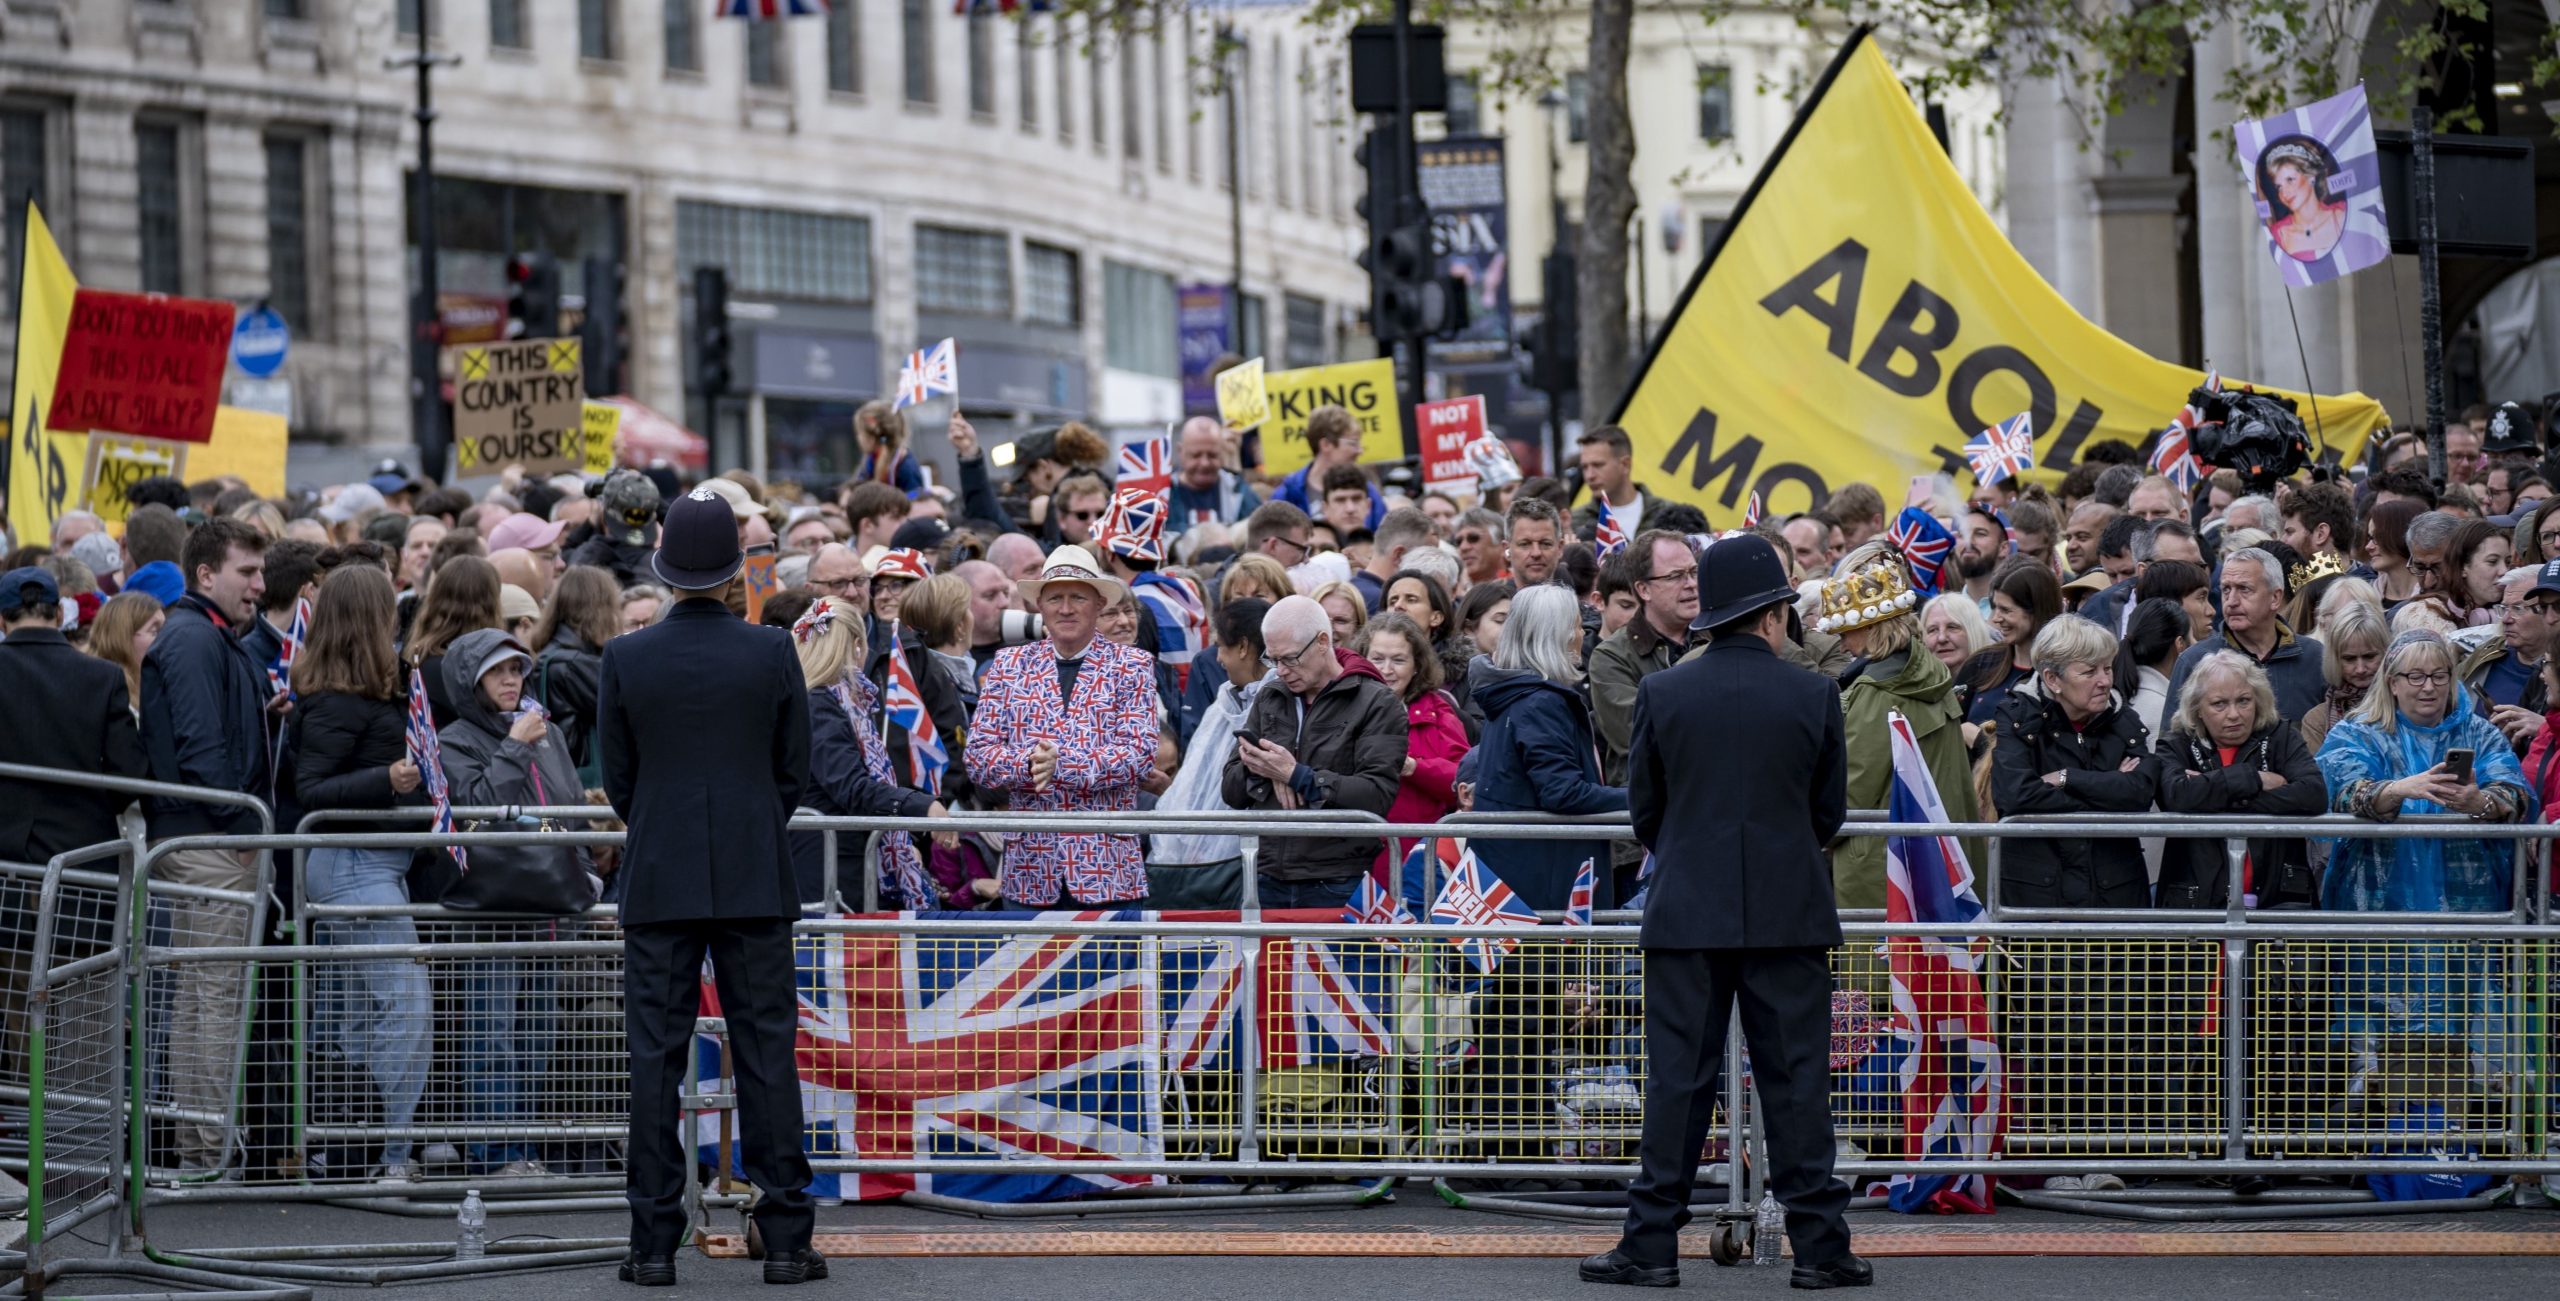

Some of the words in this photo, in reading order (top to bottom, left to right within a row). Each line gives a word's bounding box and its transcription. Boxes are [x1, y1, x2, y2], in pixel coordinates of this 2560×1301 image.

[132, 305, 168, 339] YOU
[172, 309, 229, 346] THINK
[88, 346, 128, 380] THIS
[136, 352, 155, 383] IS
[157, 355, 197, 386] ALL
[490, 344, 547, 373] THIS
[1759, 237, 2165, 474] ABOL
[462, 375, 579, 410] COUNTRY
[56, 390, 75, 418] A
[82, 390, 123, 424] BIT
[129, 395, 204, 429] SILLY?
[512, 405, 534, 430] IS
[585, 407, 614, 424] NOT
[1429, 403, 1470, 426] NOT
[480, 430, 562, 463] OURS!
[585, 431, 606, 446] MY
[1437, 431, 1467, 452] MY
[586, 452, 609, 467] NG
[1431, 459, 1469, 480] KIN
